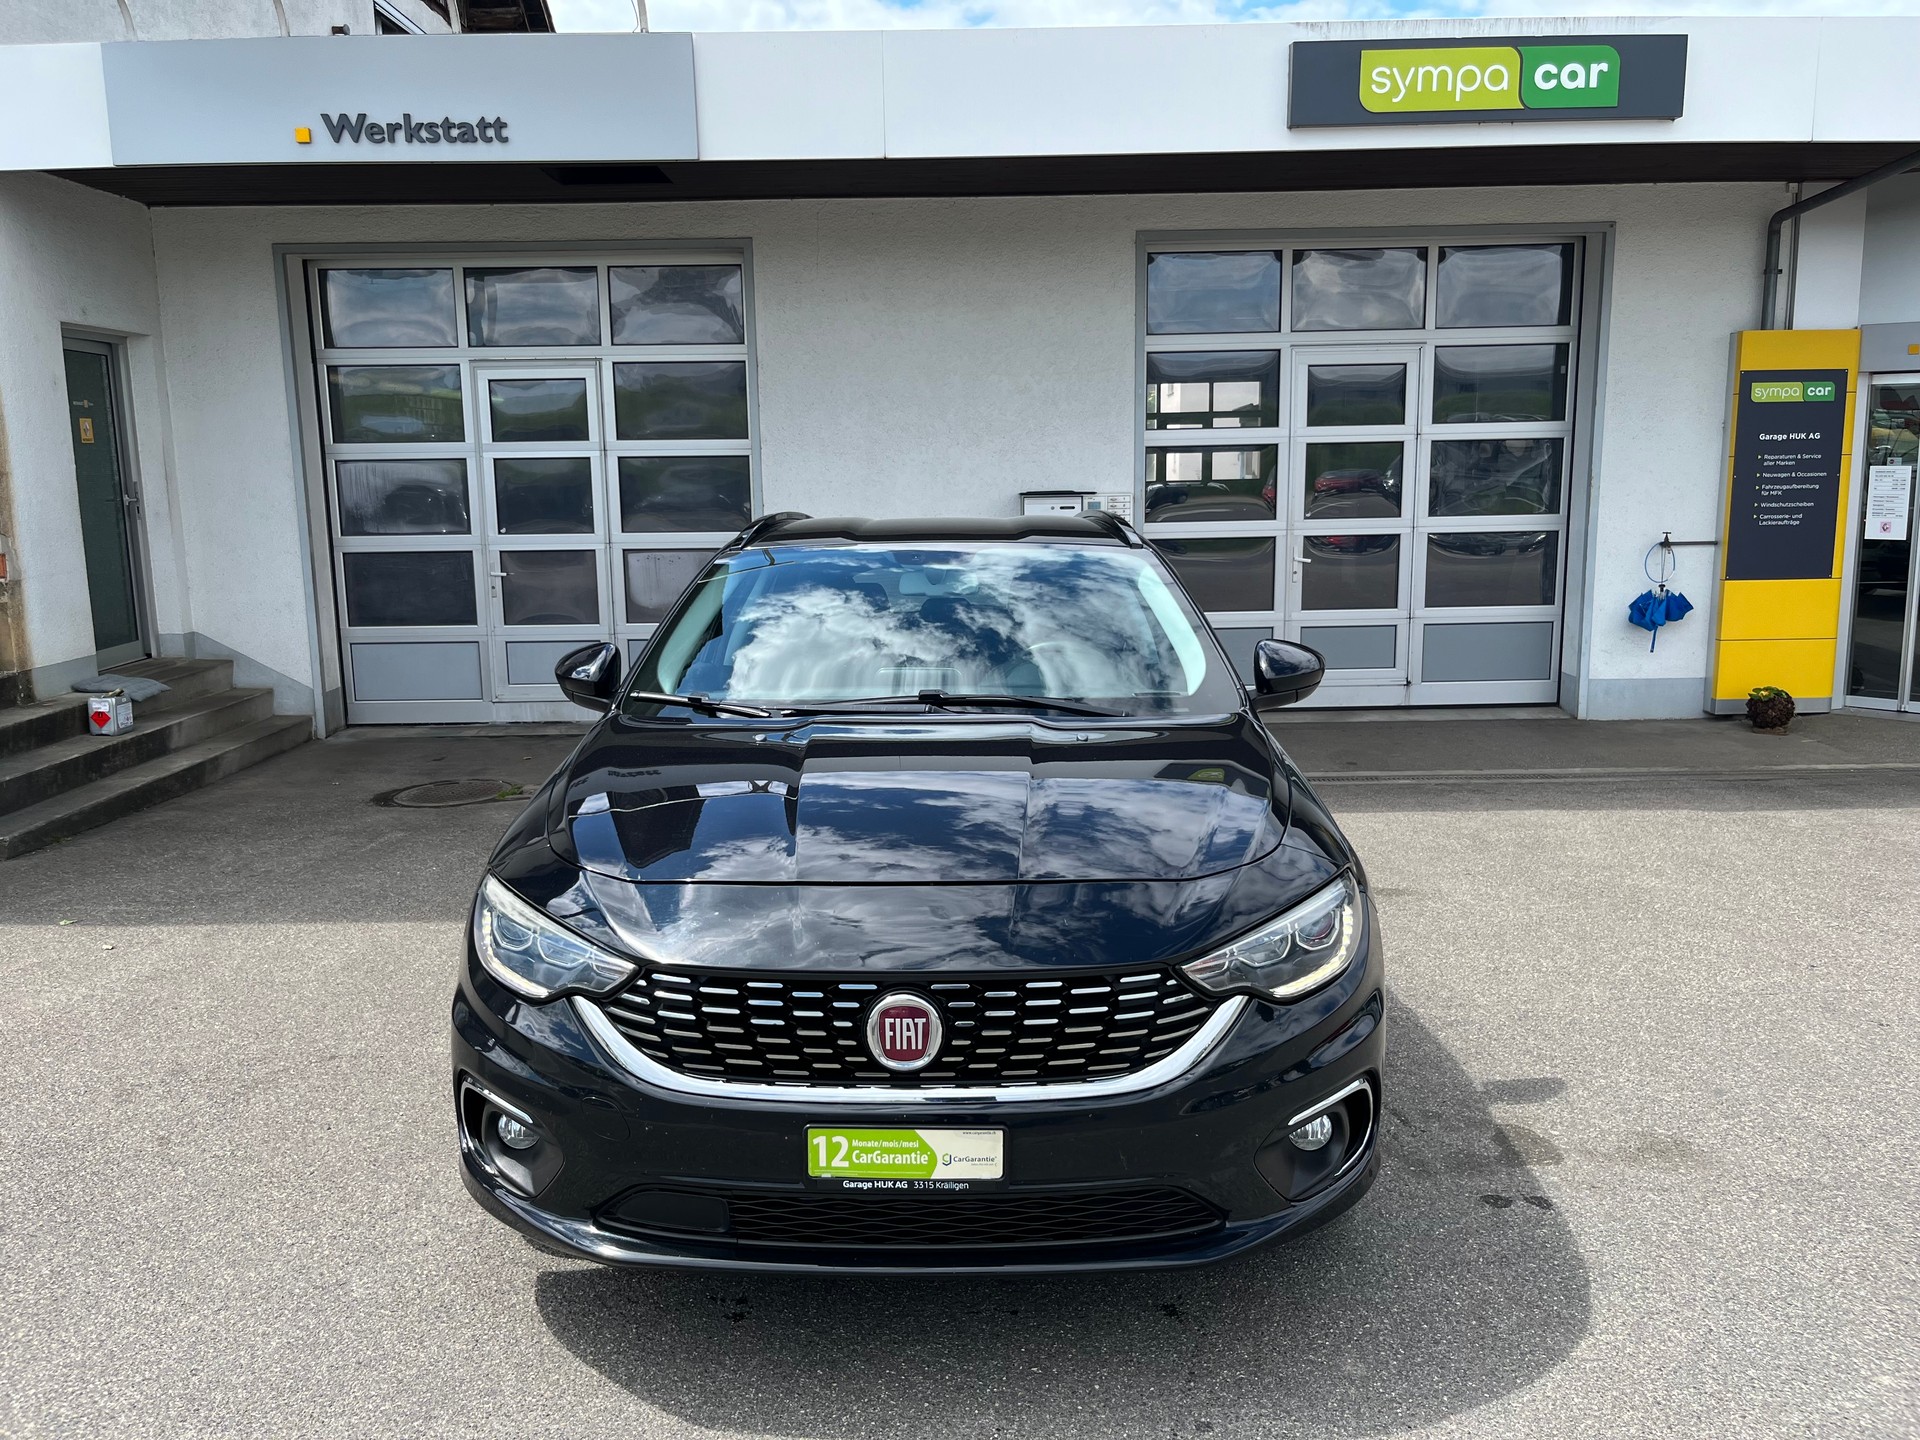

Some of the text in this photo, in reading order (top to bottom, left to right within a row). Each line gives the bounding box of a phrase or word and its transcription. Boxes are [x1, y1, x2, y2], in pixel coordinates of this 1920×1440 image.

[1371, 61, 1608, 103] sympa car
[320, 113, 509, 144] Werkstatt
[1754, 386, 1832, 400] sympa car
[1759, 433, 1787, 441] Garage
[1808, 432, 1821, 440] AG
[884, 1018, 926, 1050] FIAT
[812, 1135, 849, 1168] 12
[852, 1139, 919, 1148] Monate/mois/mesi
[843, 1180, 873, 1189] Garage
[874, 1180, 895, 1188] HUK
[895, 1180, 908, 1188] AG
[913, 1181, 934, 1189] 3315
